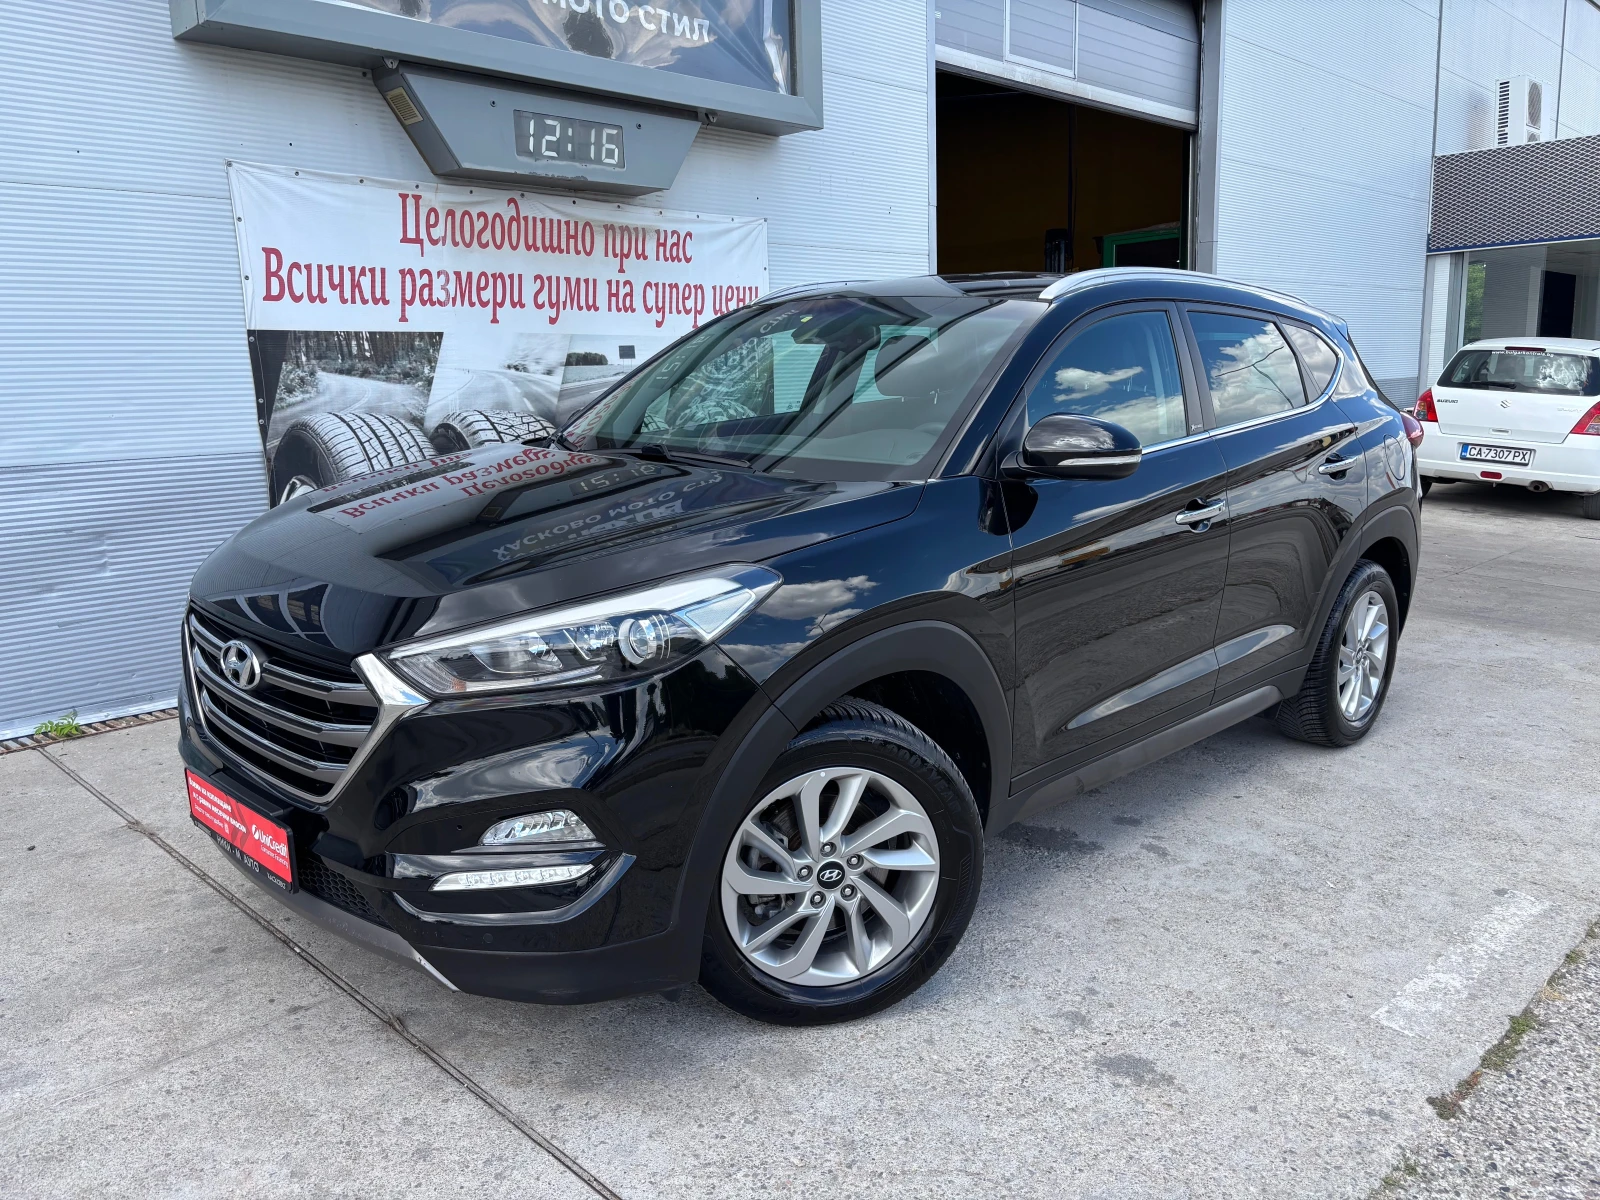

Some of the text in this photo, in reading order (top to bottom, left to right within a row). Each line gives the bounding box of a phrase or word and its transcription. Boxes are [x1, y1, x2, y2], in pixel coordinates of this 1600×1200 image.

[638, 4, 710, 43] СТИЛ
[529, 118, 619, 165] 12:16
[398, 192, 693, 274] Целогодишно при нас
[262, 246, 390, 306] Всички
[398, 267, 526, 324] размери
[533, 273, 600, 326] гуми
[606, 278, 637, 314] на
[642, 280, 706, 329] супер
[259, 828, 289, 859] UniCredit
